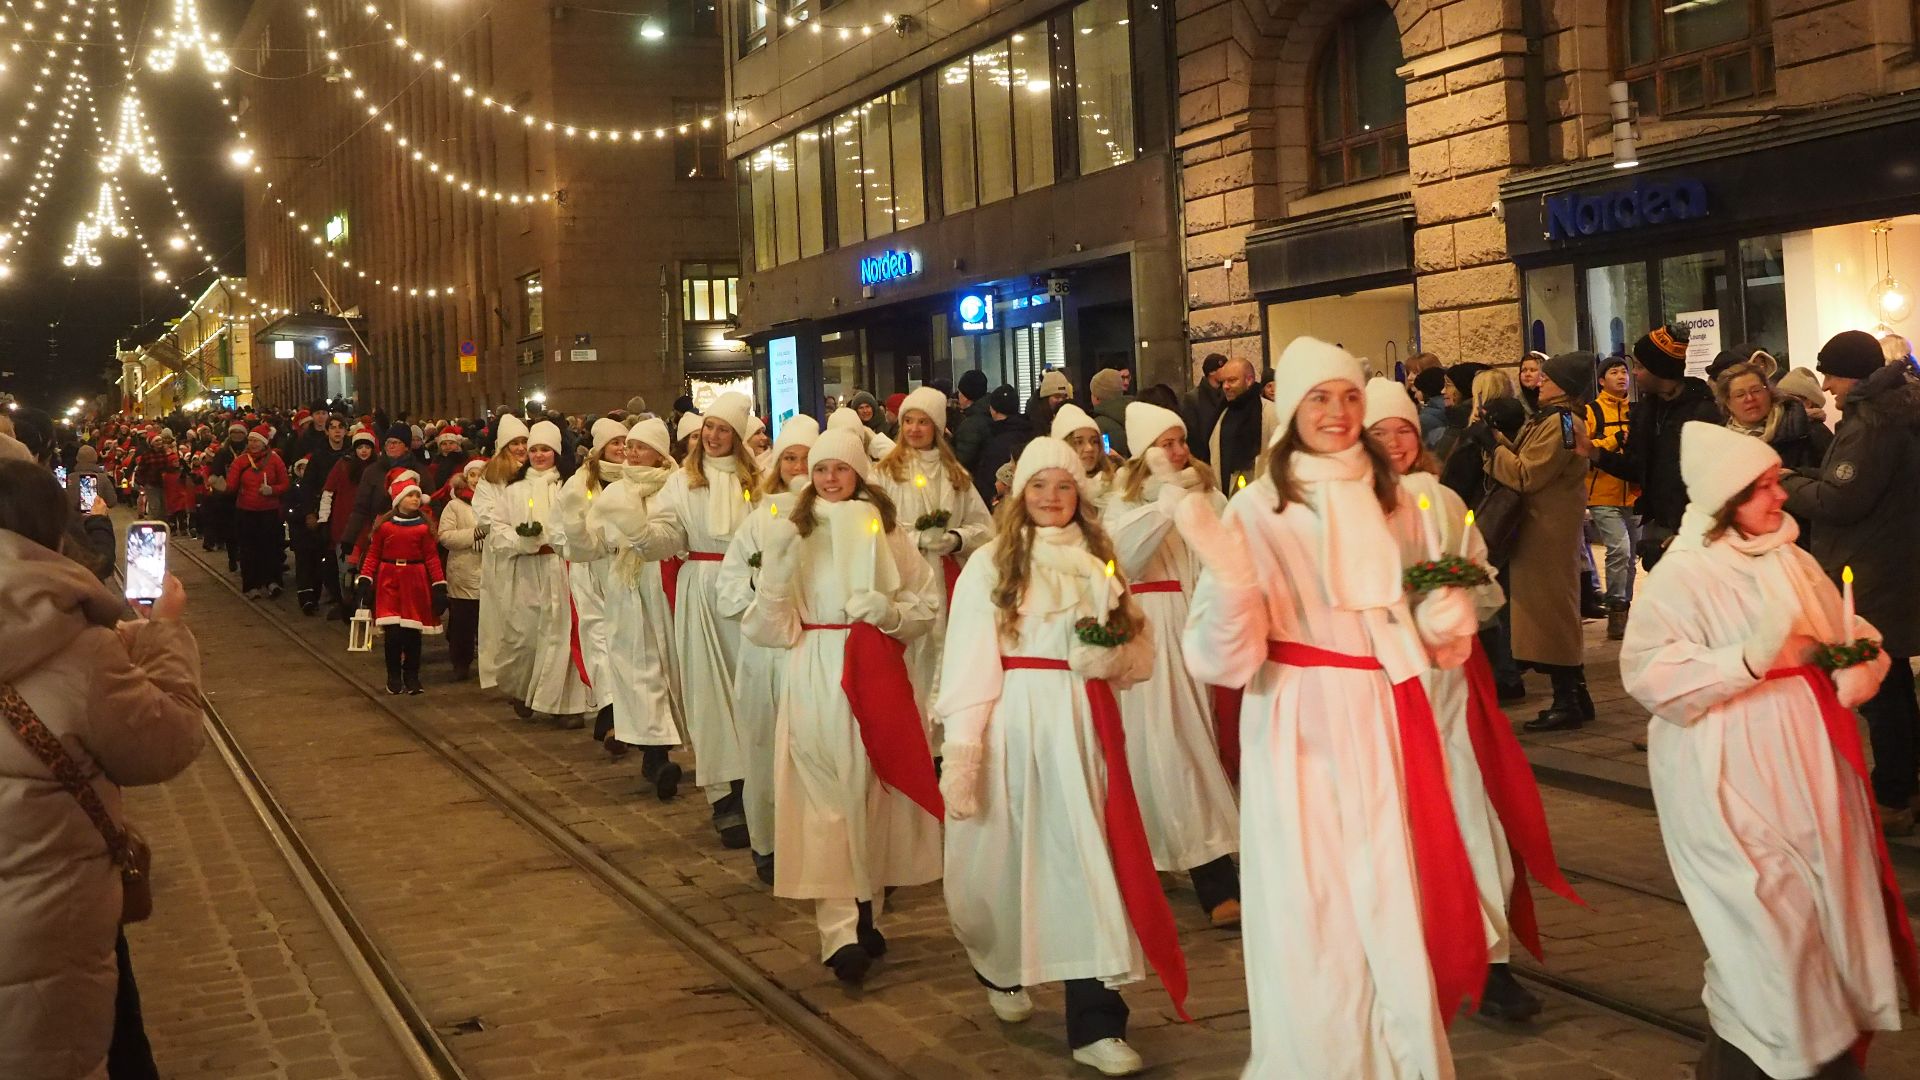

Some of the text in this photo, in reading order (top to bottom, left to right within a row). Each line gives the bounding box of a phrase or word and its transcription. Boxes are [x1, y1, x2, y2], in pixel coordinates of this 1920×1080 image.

[1547, 176, 1707, 240] Nordea
[861, 250, 909, 285] Nordea
[1054, 282, 1069, 293] 36
